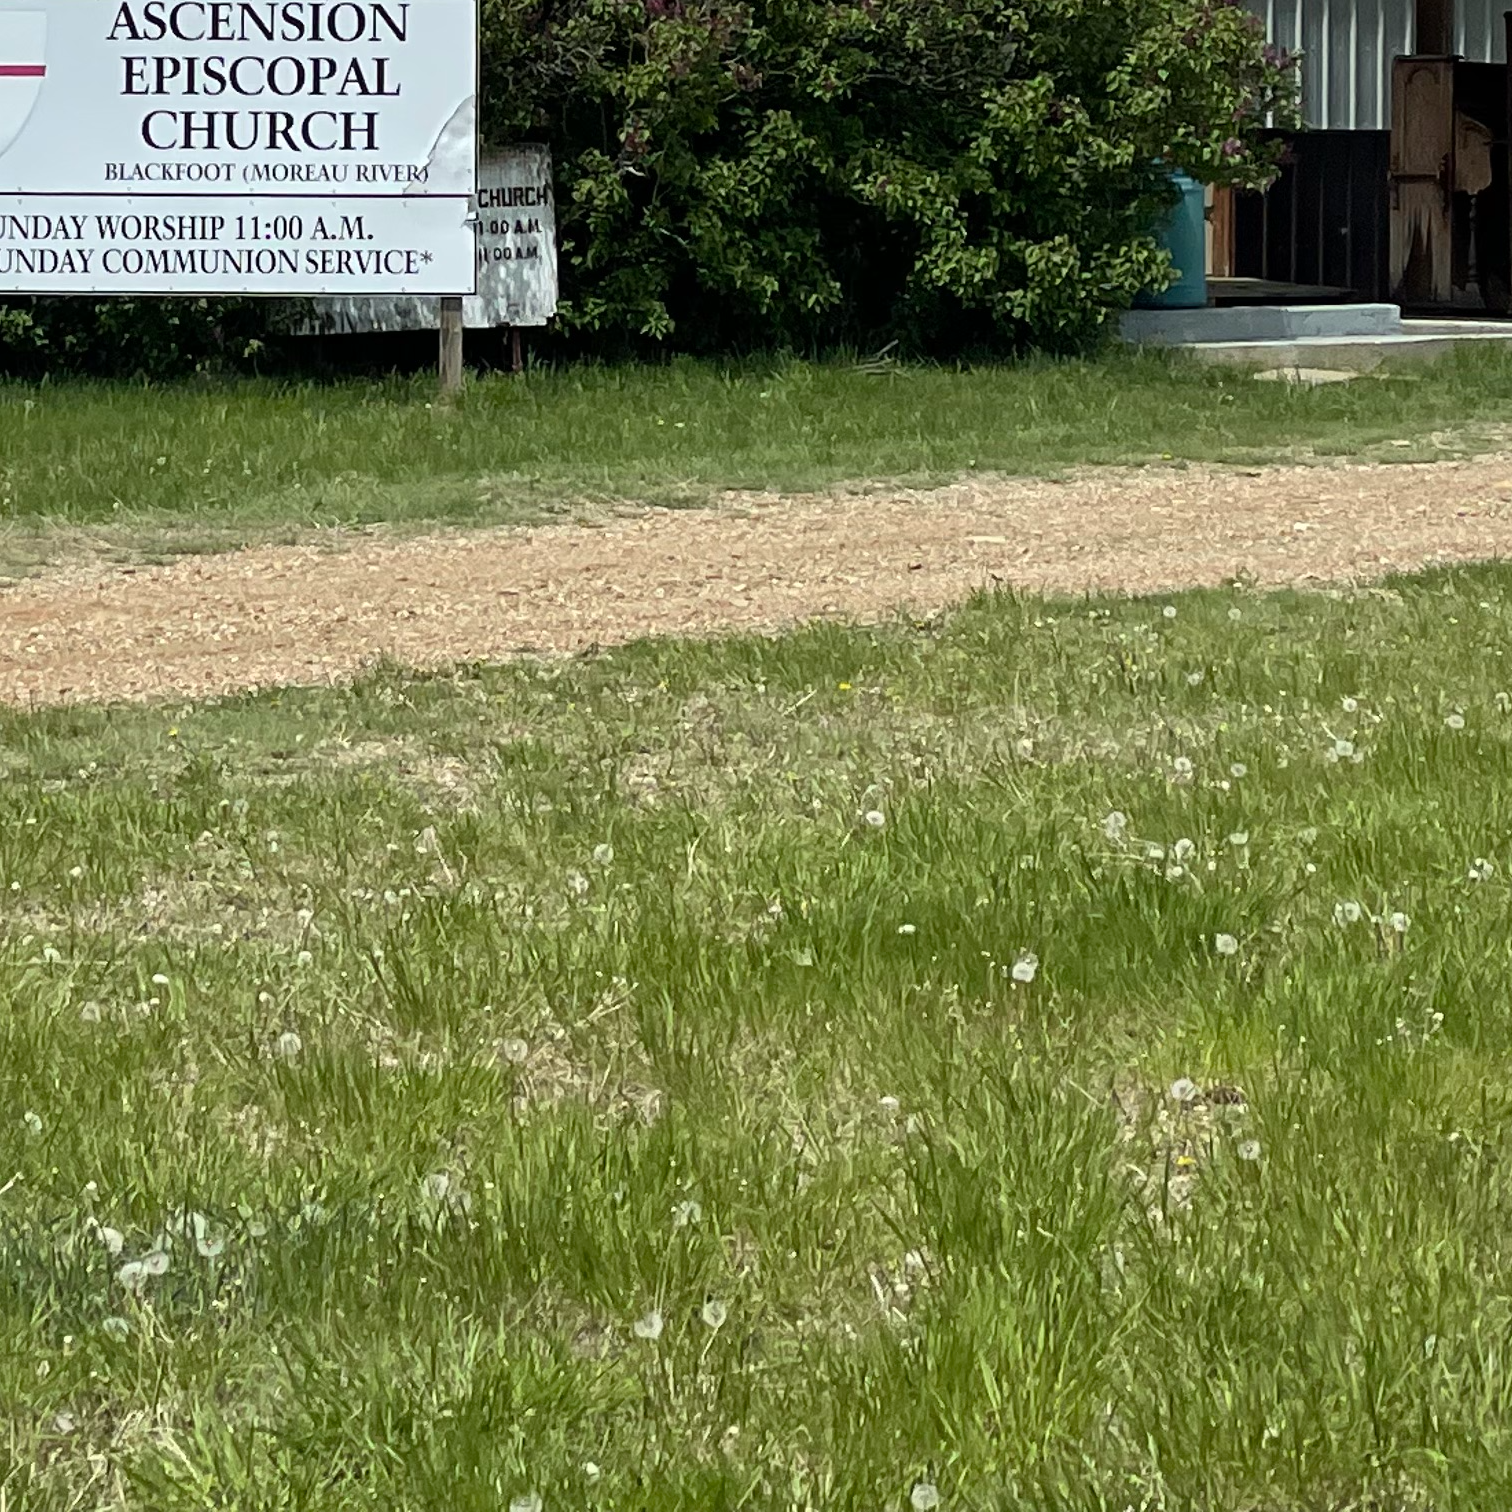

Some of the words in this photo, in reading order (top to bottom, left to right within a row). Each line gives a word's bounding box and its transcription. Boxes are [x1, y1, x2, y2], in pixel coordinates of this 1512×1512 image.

[105, 0, 410, 42] ASCENSION
[119, 55, 401, 97] EPISCOPAL
[141, 109, 380, 152] CHURCH
[104, 162, 236, 182] BLACKFOOT
[243, 162, 348, 184] (MOREAU
[356, 162, 430, 184] RIVER)
[478, 185, 549, 208] CHURCH
[94, 215, 225, 241] WORSHIP
[235, 215, 303, 241] 11:00
[309, 215, 374, 240] A.M.
[102, 248, 300, 274] COMMUNION
